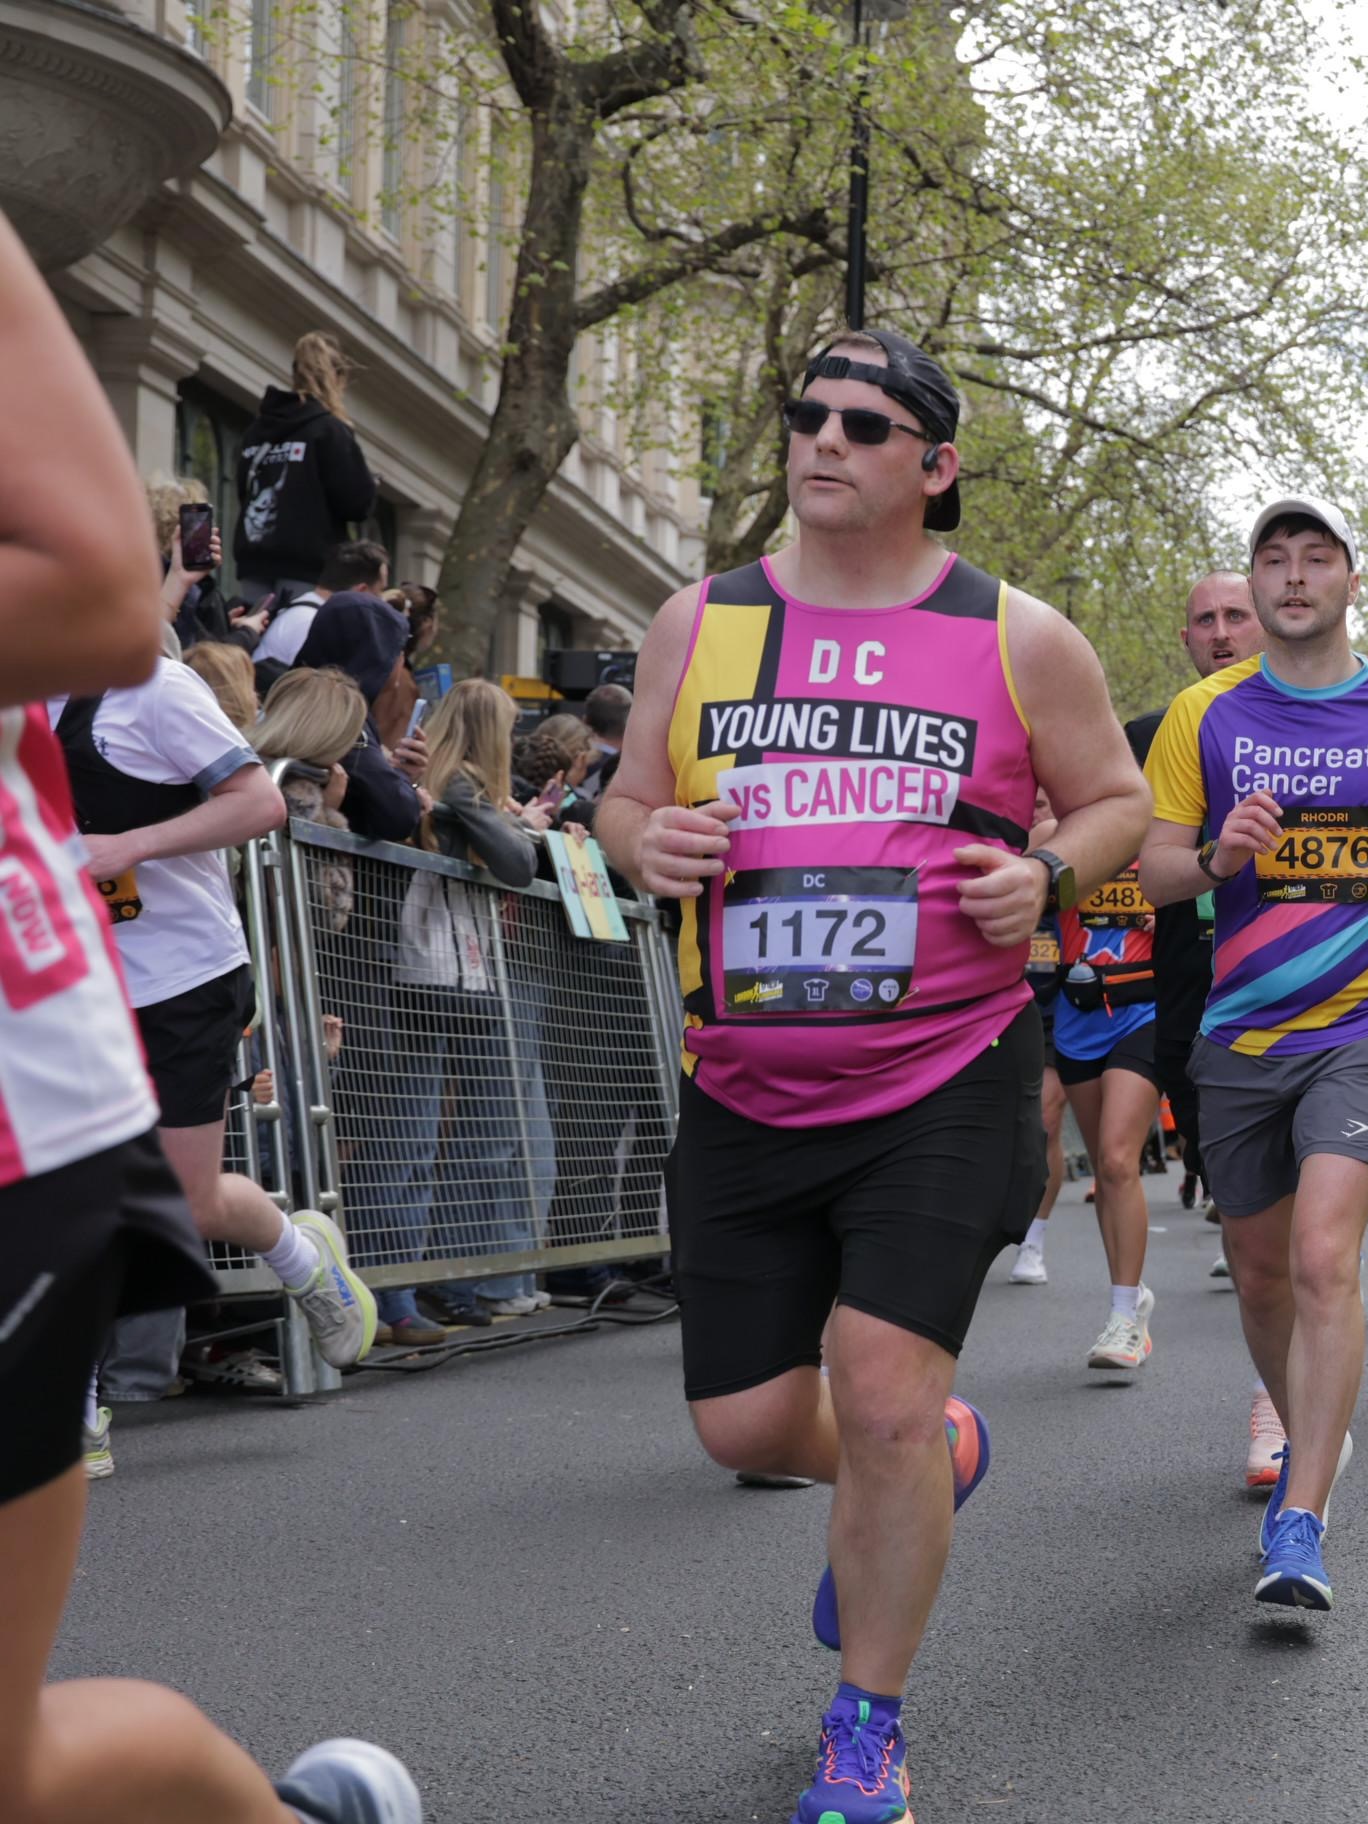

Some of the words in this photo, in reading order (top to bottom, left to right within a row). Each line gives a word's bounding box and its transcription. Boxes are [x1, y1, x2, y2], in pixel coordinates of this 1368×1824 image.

[710, 704, 840, 752] YOUNG
[850, 707, 968, 768] LIVES
[784, 766, 949, 817] CANCER
[1232, 765, 1342, 796] Cancer
[1301, 812, 1349, 822] RHODRI
[803, 873, 826, 889] DC
[749, 908, 887, 958] 1172
